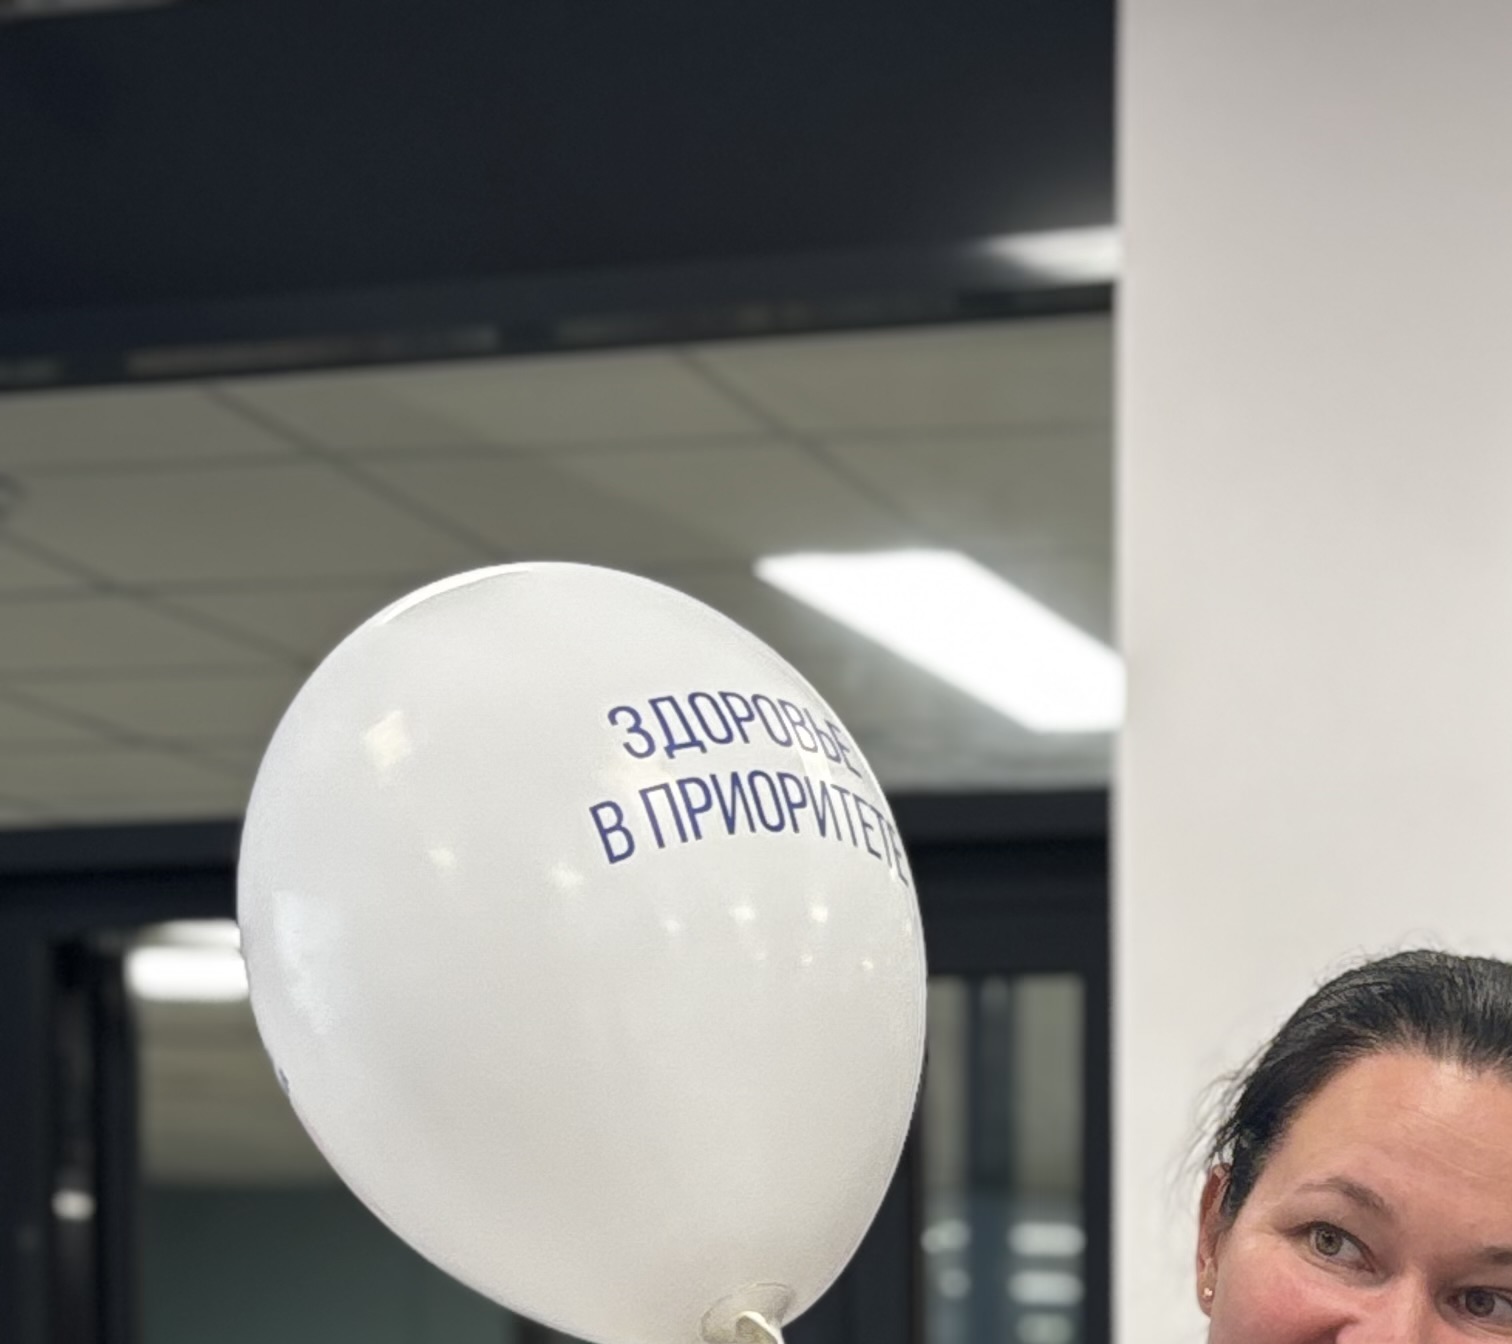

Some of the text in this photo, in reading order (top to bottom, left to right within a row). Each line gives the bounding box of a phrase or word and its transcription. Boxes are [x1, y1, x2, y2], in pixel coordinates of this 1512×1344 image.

[607, 691, 863, 779] ЗДОРОВЬЕ
[589, 770, 909, 887] В ПРИОРИТЕТЕ
